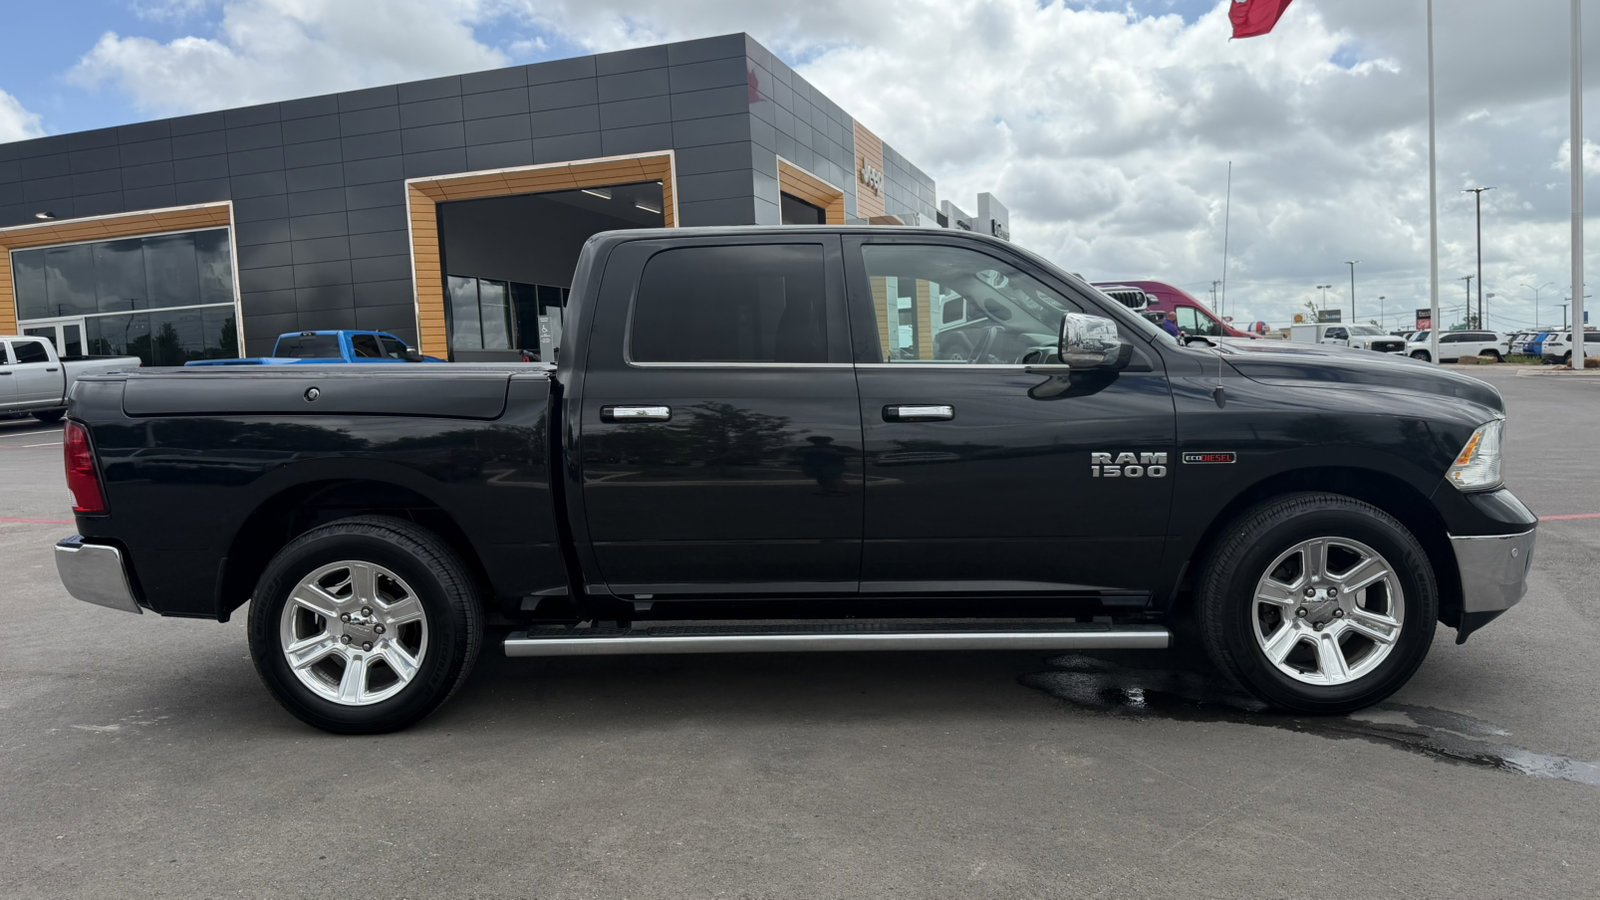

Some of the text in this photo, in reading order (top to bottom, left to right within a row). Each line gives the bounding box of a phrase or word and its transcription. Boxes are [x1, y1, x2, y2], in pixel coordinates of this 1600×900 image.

[860, 157, 884, 196] Jeep
[1091, 452, 1168, 464] RAM
[1091, 465, 1168, 478] 1500
